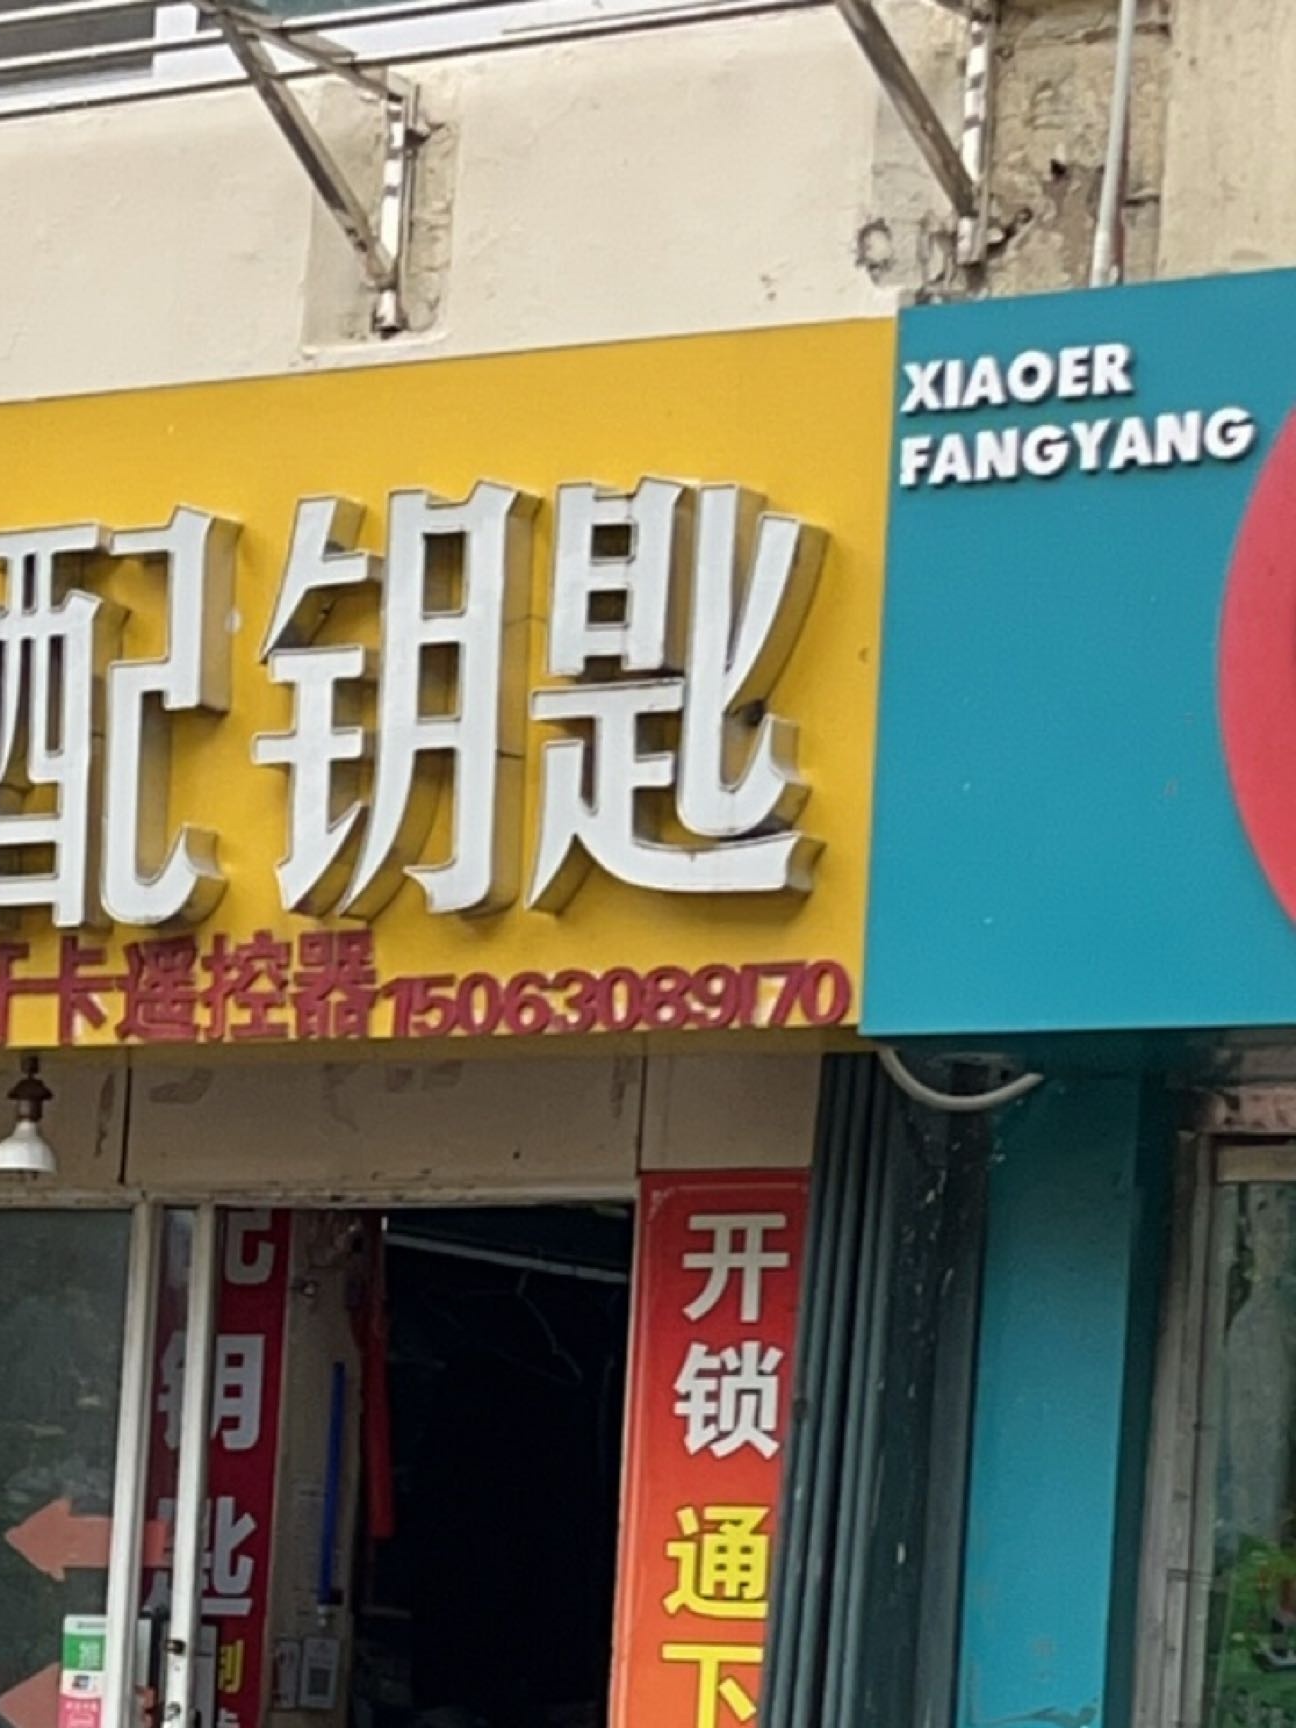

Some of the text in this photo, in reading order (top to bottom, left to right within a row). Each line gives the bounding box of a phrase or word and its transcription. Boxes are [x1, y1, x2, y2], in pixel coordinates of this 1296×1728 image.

[900, 343, 1133, 413] XIAOER
[900, 407, 1255, 488] FANGYANG
[380, 959, 851, 1038] 15063089170
[672, 1212, 789, 1461] 开锁
